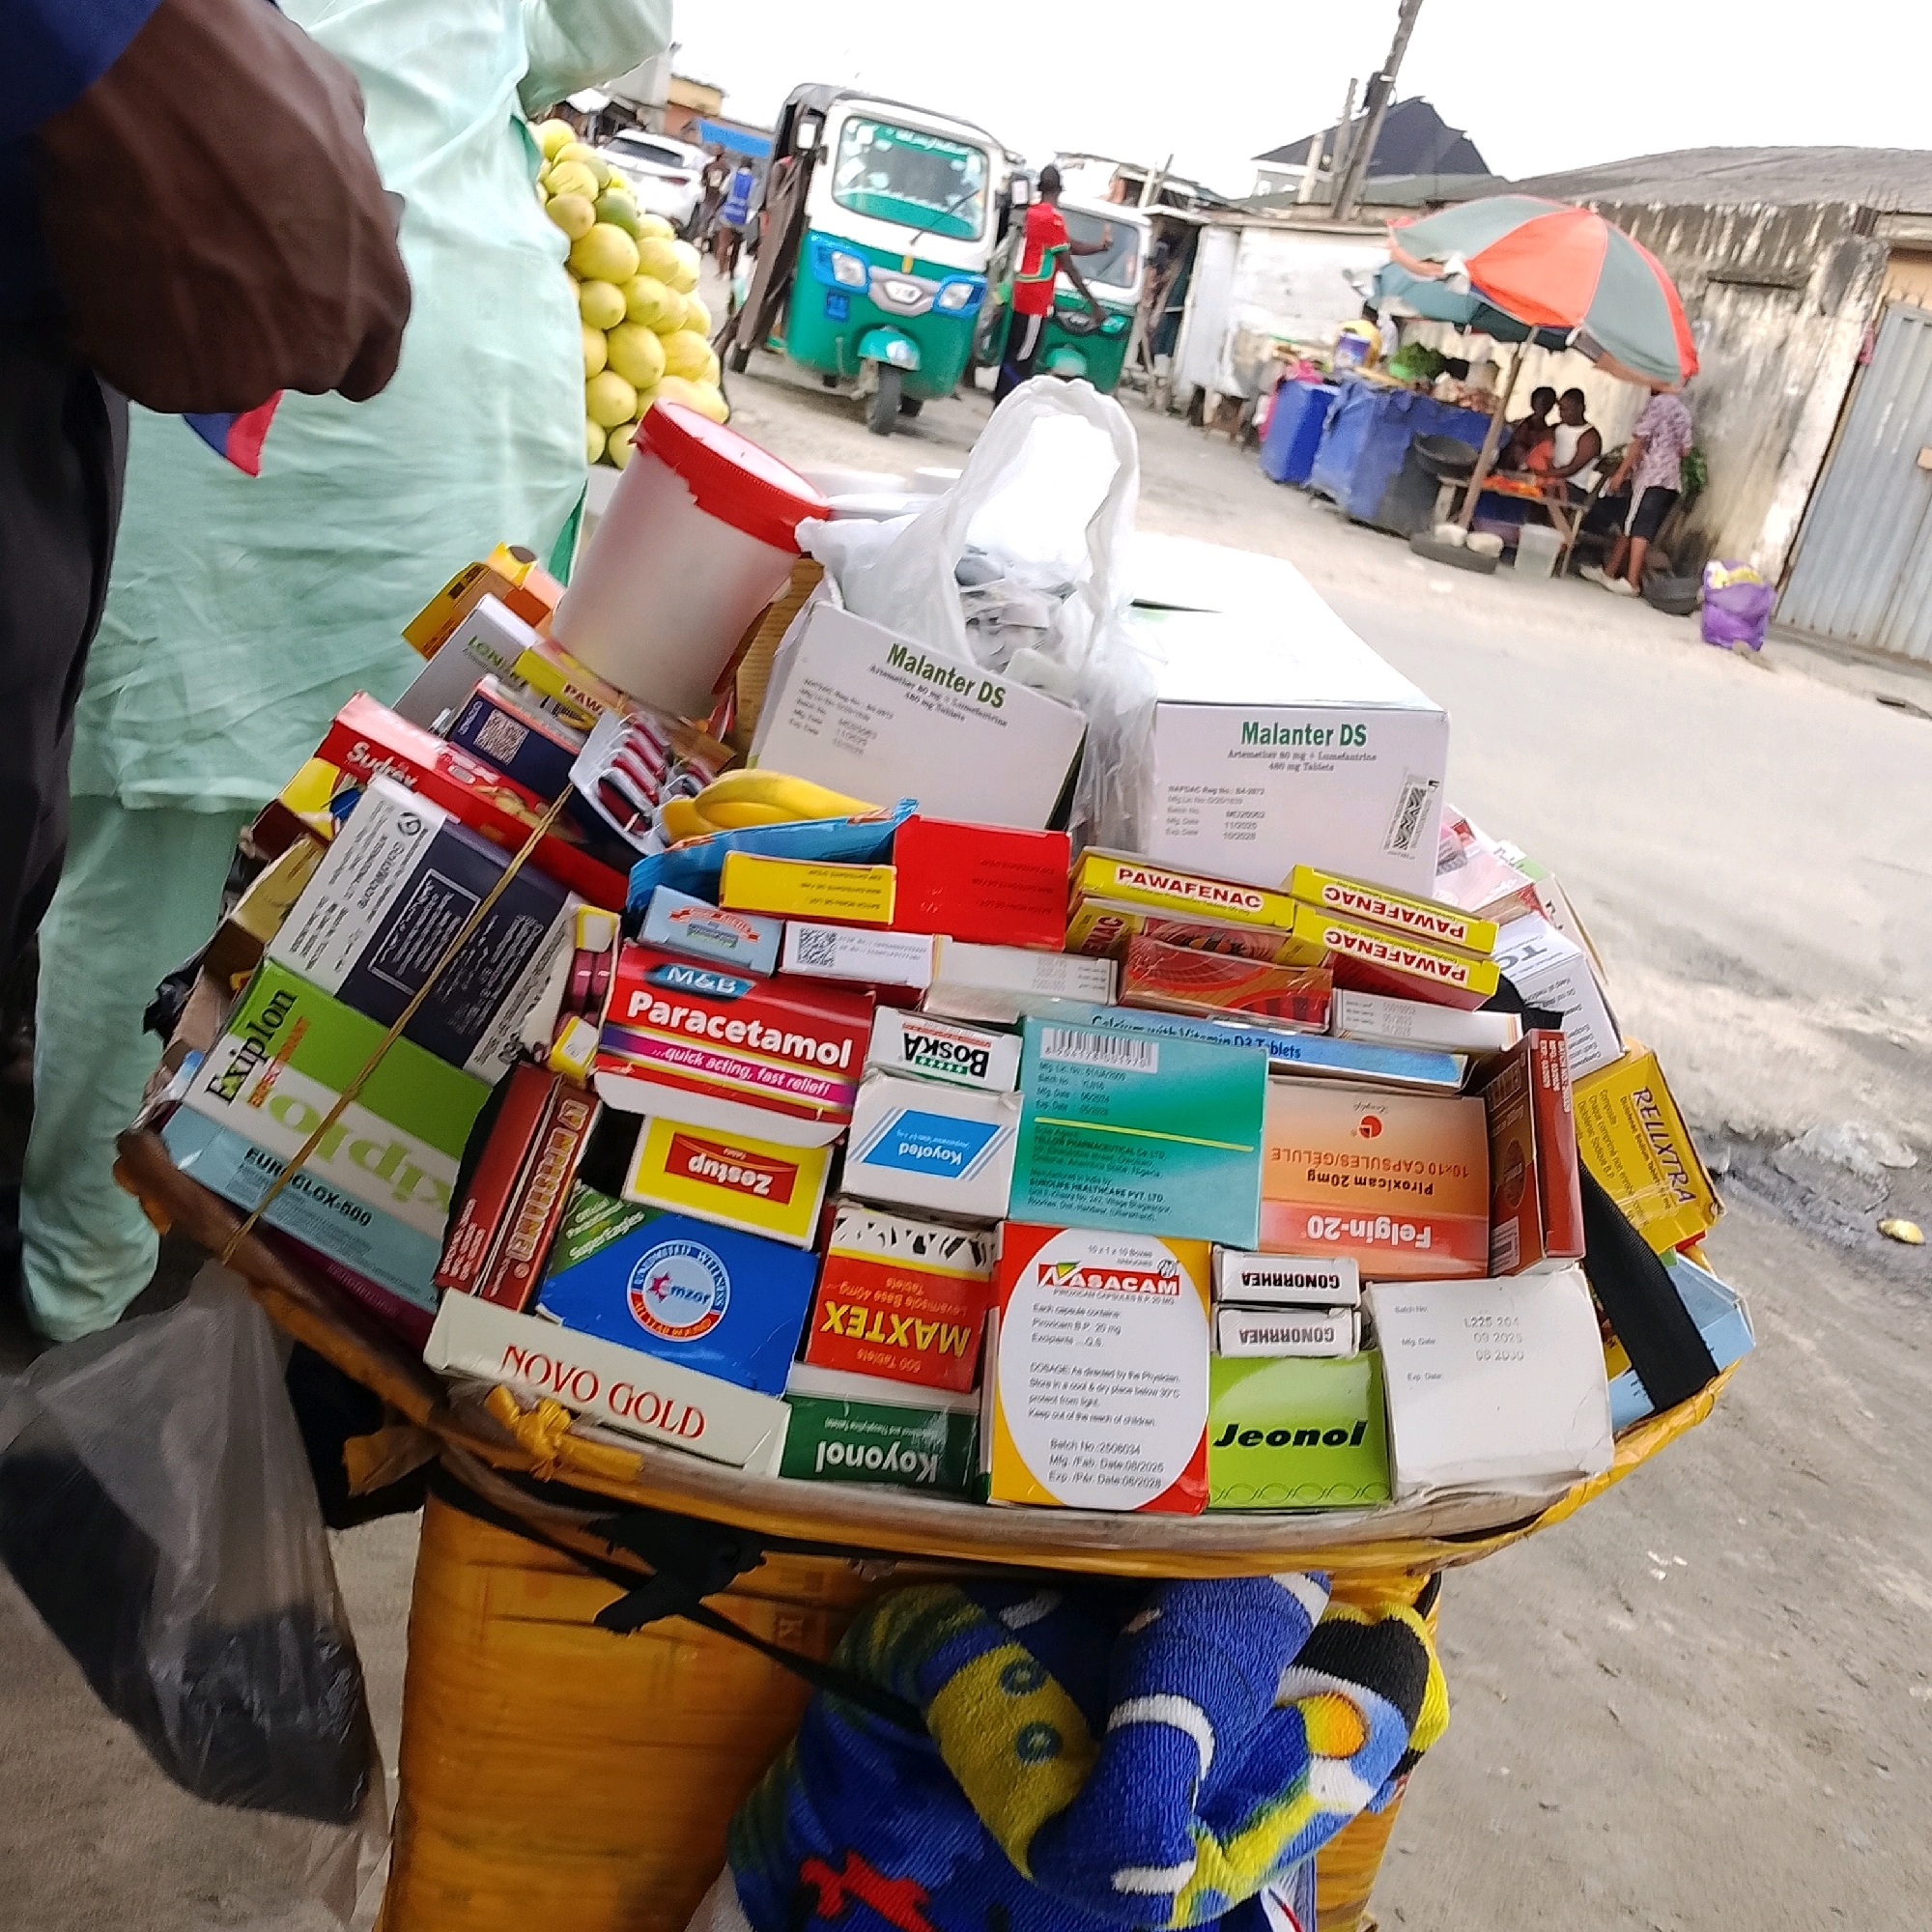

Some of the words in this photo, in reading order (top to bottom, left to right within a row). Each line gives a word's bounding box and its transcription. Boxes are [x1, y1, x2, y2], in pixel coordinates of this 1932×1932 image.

[887, 643, 975, 696] Malanter
[978, 681, 1007, 708] DS
[1241, 721, 1334, 746] Malanter
[1340, 724, 1366, 747] DS
[1117, 867, 1263, 909] PAWAFENAC
[1323, 886, 1465, 941] PAWAFENAC
[1324, 930, 1466, 982] PAWAFENAC
[667, 965, 737, 994] M&B
[204, 988, 298, 1106] Exiplon
[627, 990, 853, 1069] Paracetamol
[706, 1056, 752, 1079] acting,
[757, 1066, 784, 1085] fast
[897, 1139, 962, 1166] Koyofed
[688, 1154, 774, 1195] Zostup
[1307, 1170, 1350, 1187] 20mg
[1353, 1178, 1435, 1195] Piroxicam
[1307, 1214, 1432, 1248] Felgin-20
[1241, 1272, 1341, 1290] GONORRHEA
[821, 1301, 972, 1358] MAXTEX
[1237, 1327, 1335, 1345] GONORRHEA
[500, 1344, 600, 1404] NOVO
[607, 1381, 707, 1440] GOLD
[1212, 1420, 1369, 1448] Jeonol
[815, 1440, 940, 1484] Koyonol
